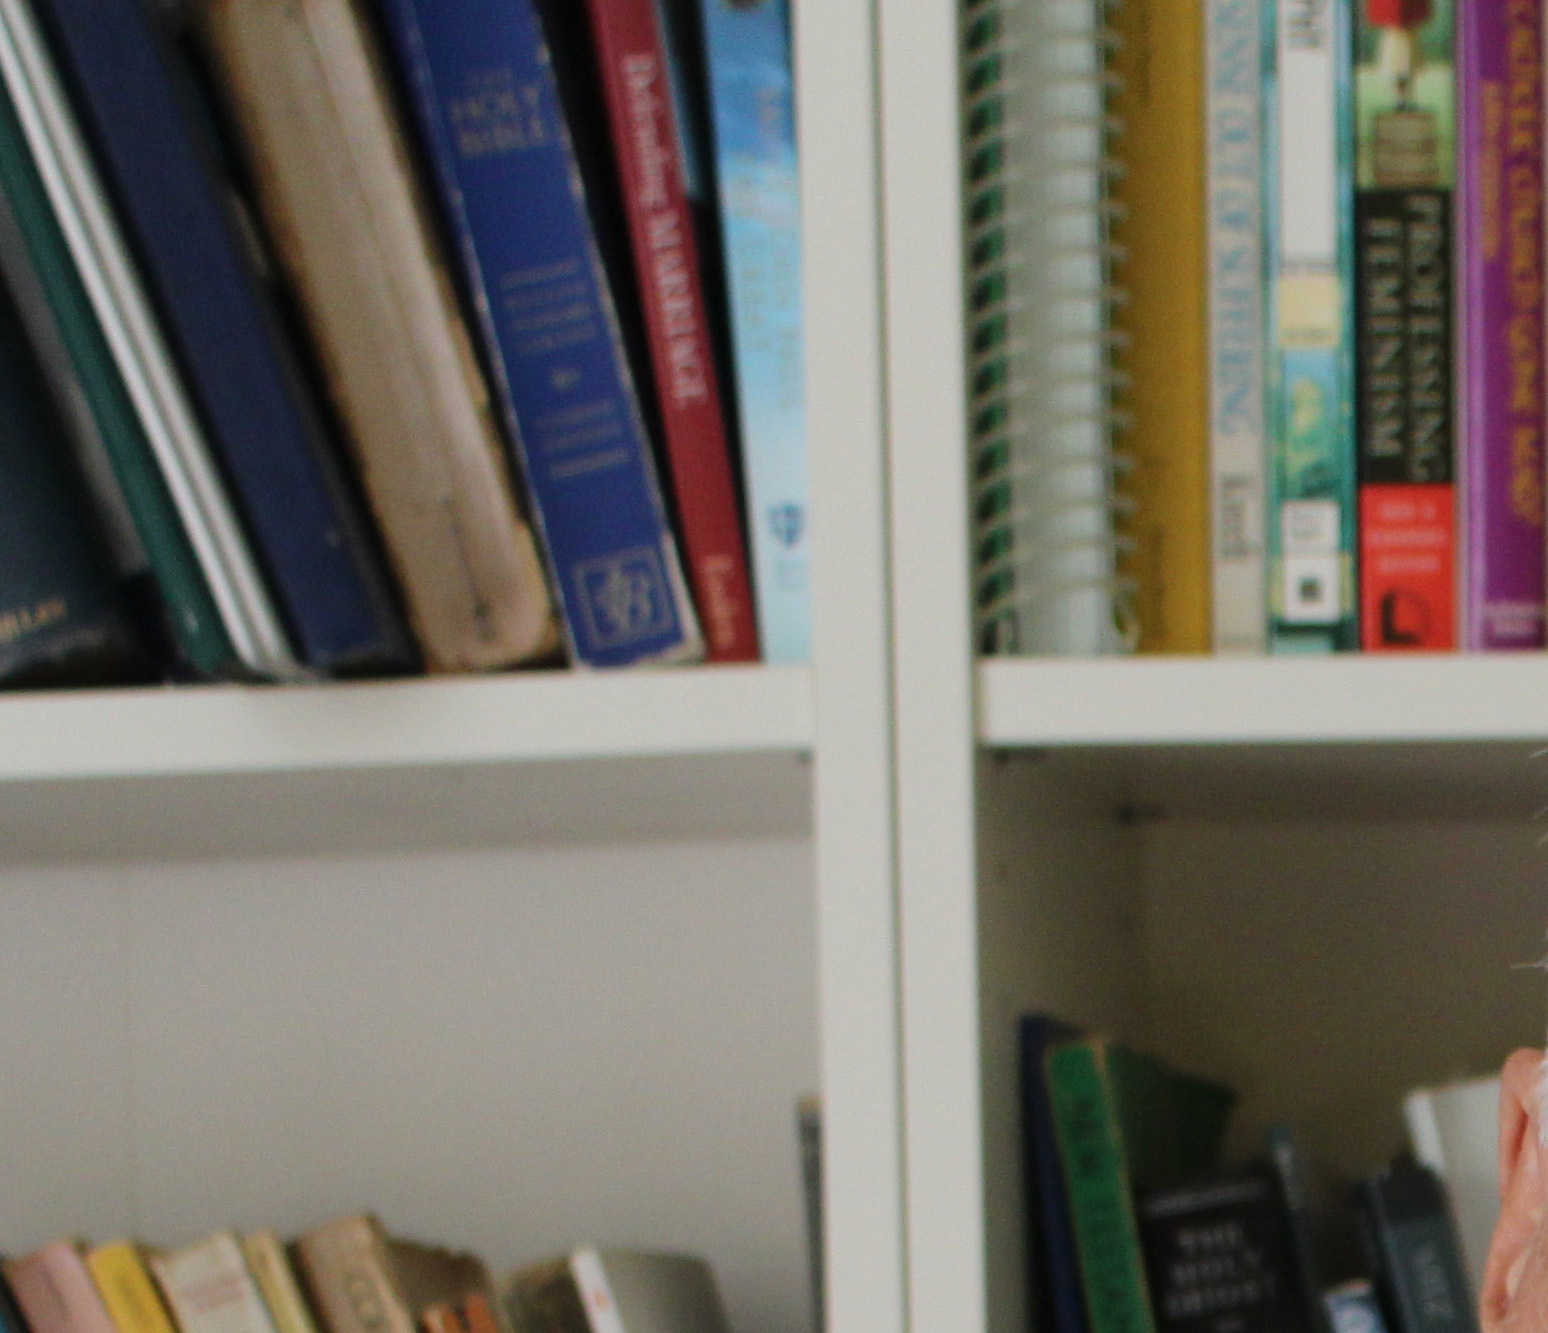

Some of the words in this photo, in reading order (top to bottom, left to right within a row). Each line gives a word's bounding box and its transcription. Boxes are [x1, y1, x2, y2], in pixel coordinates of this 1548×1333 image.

[641, 208, 710, 406] MARRIAGE
[1362, 218, 1404, 456] FEMINISM
[1406, 193, 1446, 481] PROFESSING
